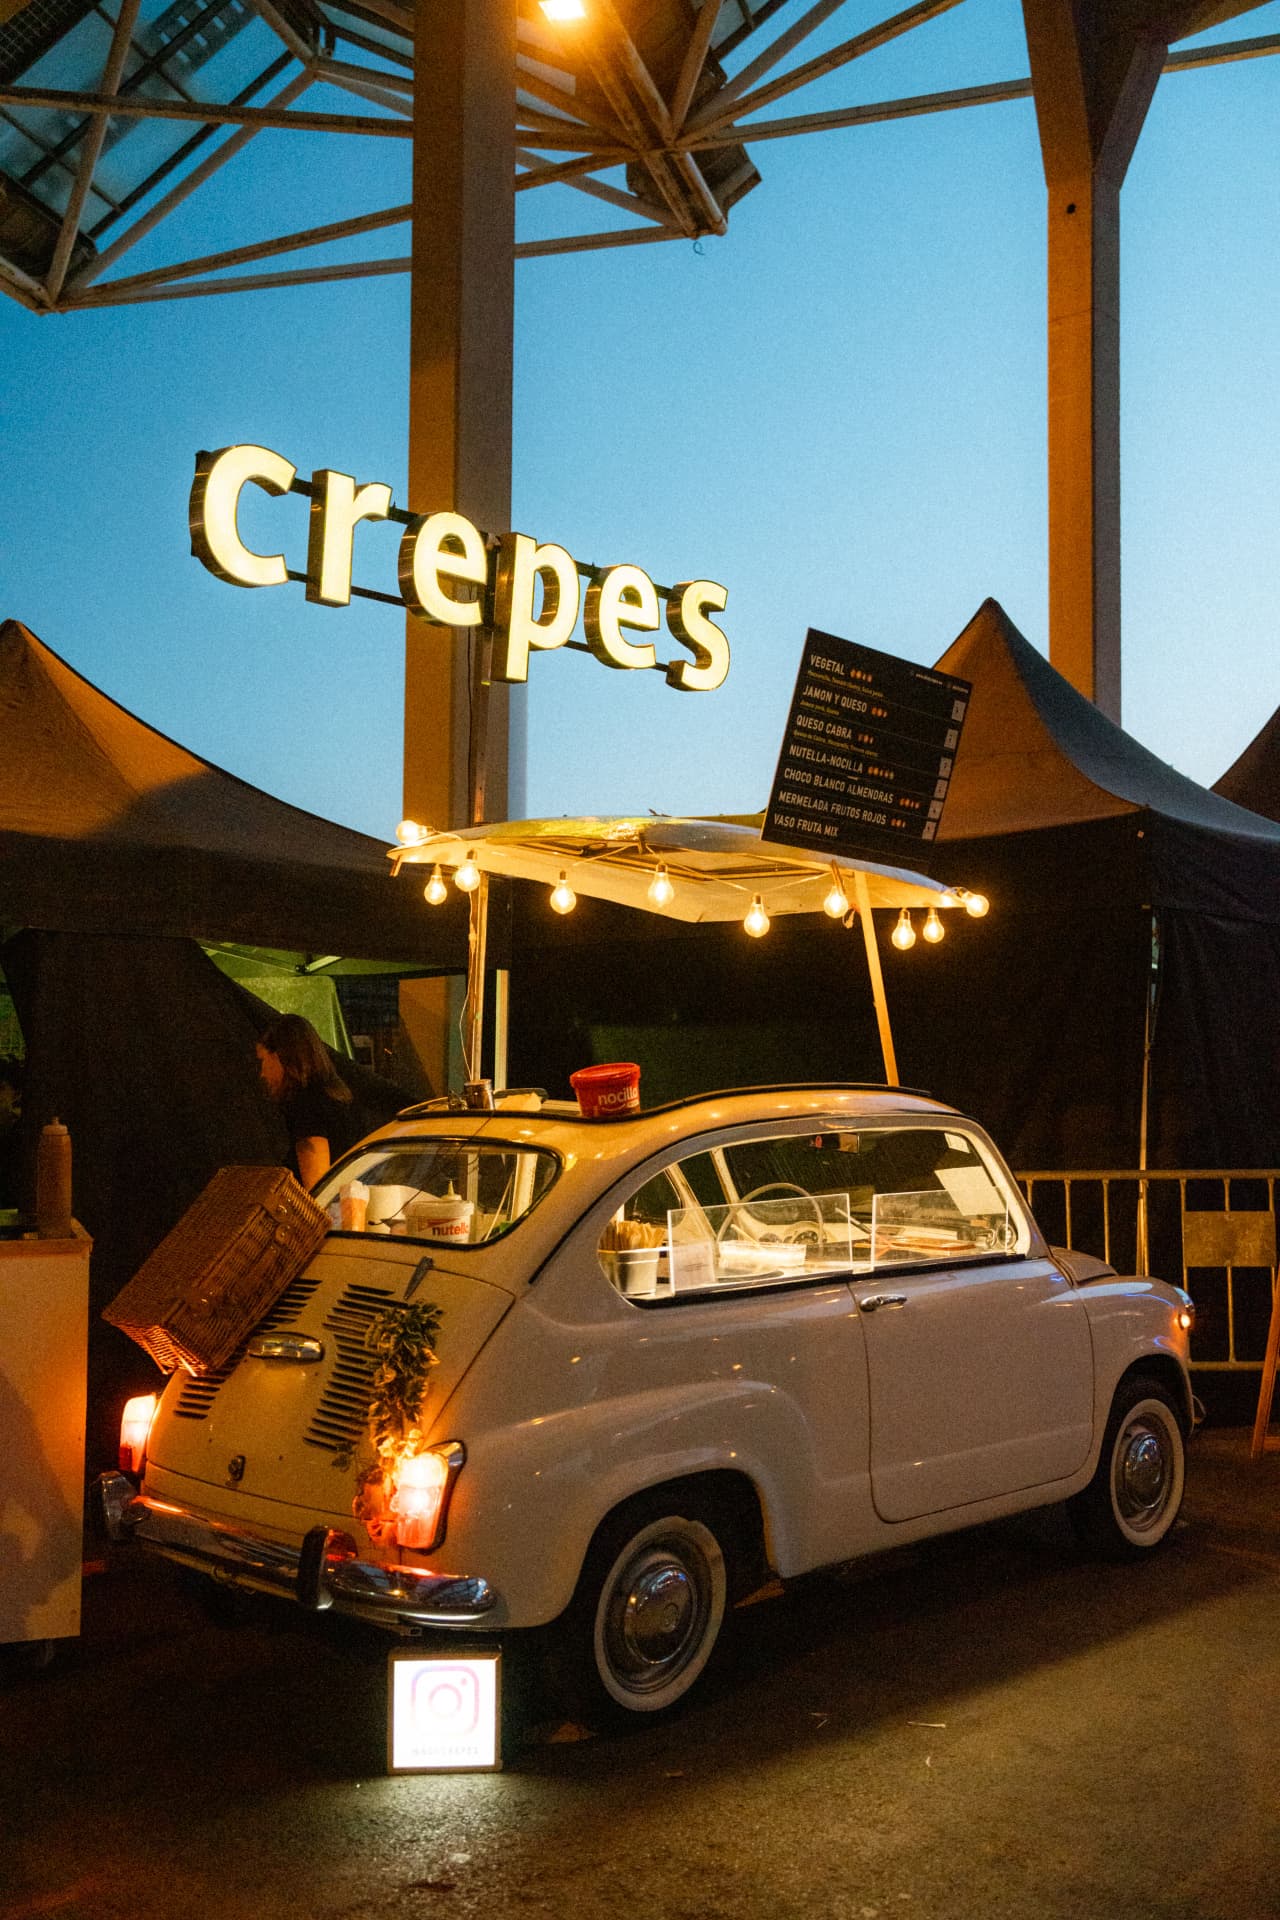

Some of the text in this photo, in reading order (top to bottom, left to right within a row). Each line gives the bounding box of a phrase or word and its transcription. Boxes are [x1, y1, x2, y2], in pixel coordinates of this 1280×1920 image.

[193, 444, 731, 692] crepes
[810, 654, 845, 676] VEGETAL
[803, 685, 833, 703] JAMON
[834, 693, 841, 705] Y
[841, 696, 868, 713] QUESO
[796, 714, 853, 739] QUESO CABRA
[789, 744, 863, 774] NUTELLA-NOCILLA
[784, 767, 894, 804] CHOCO BLANCO ALMENDRAS
[778, 791, 887, 825] MERMELADA FRUTOS ROJOS
[774, 813, 839, 837] VASO FRUTA MIX
[598, 1087, 639, 1105] nocilla
